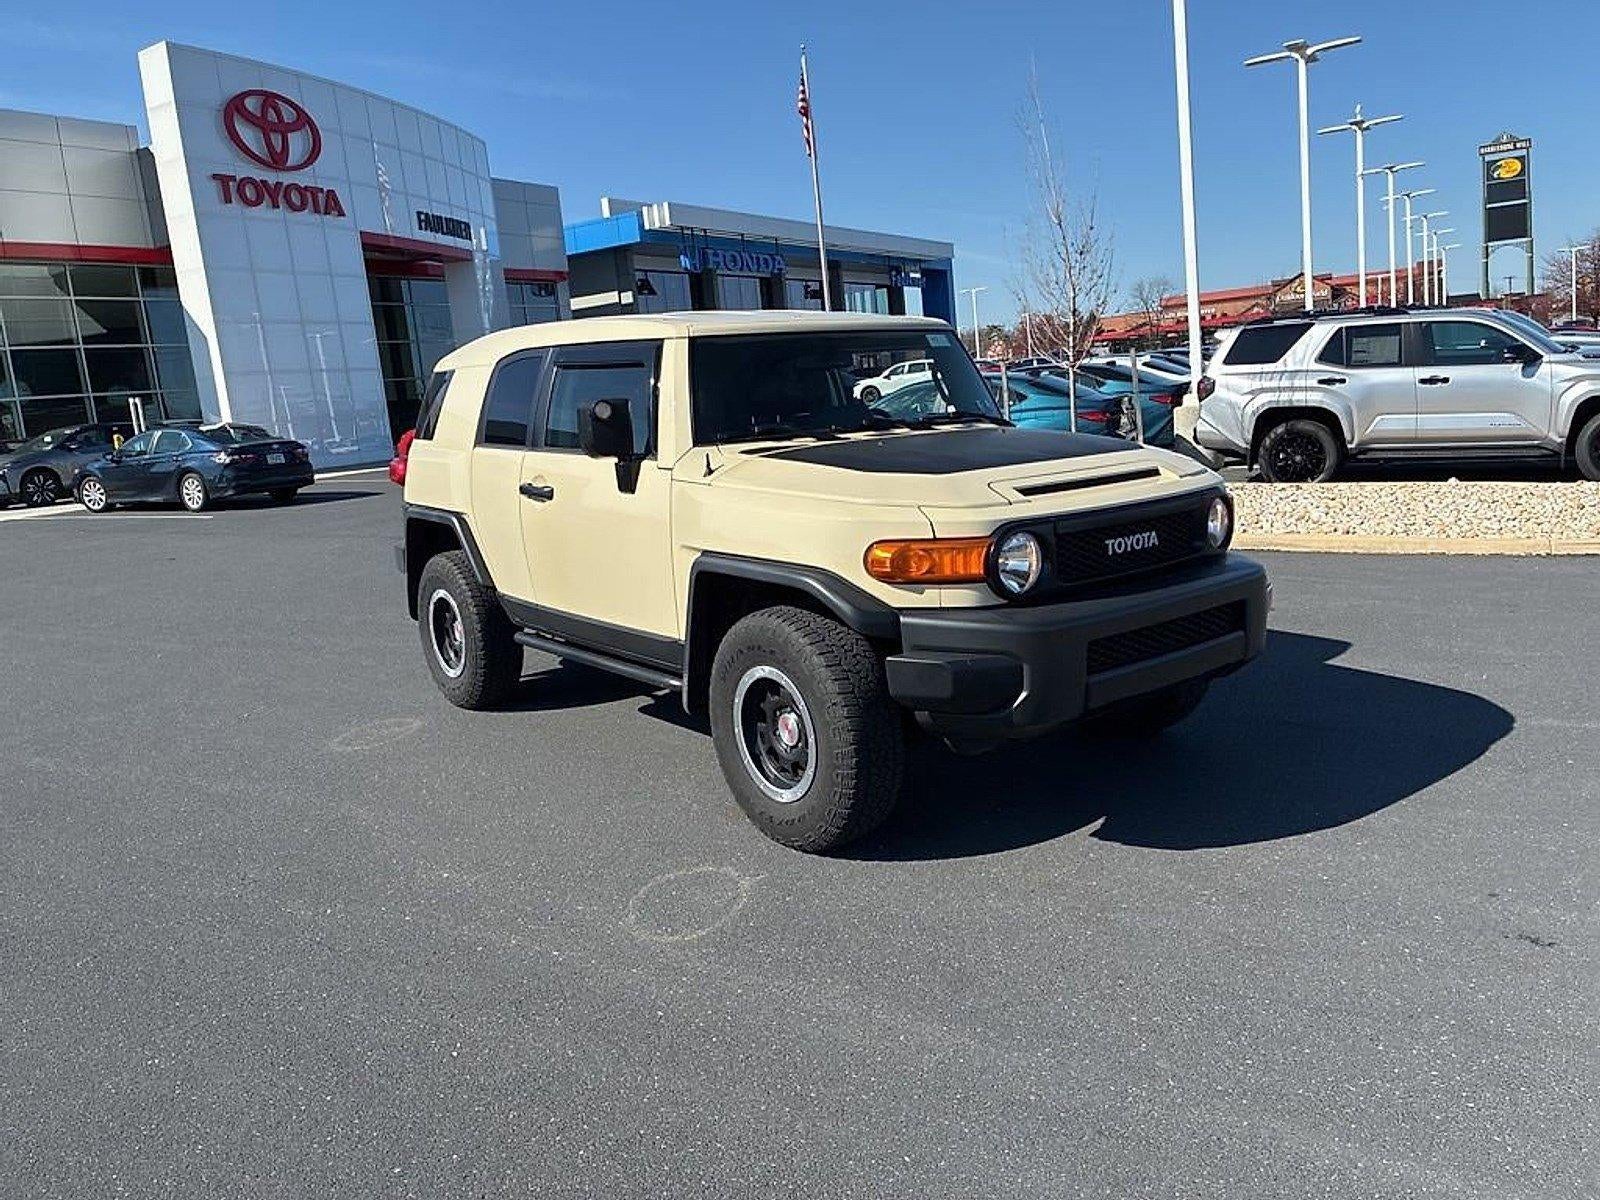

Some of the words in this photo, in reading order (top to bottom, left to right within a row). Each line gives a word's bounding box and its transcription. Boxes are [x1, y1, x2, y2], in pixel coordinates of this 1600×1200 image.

[212, 173, 346, 217] TOYOTA
[702, 246, 786, 273] HONDA
[1104, 530, 1159, 556] TOYOTA
